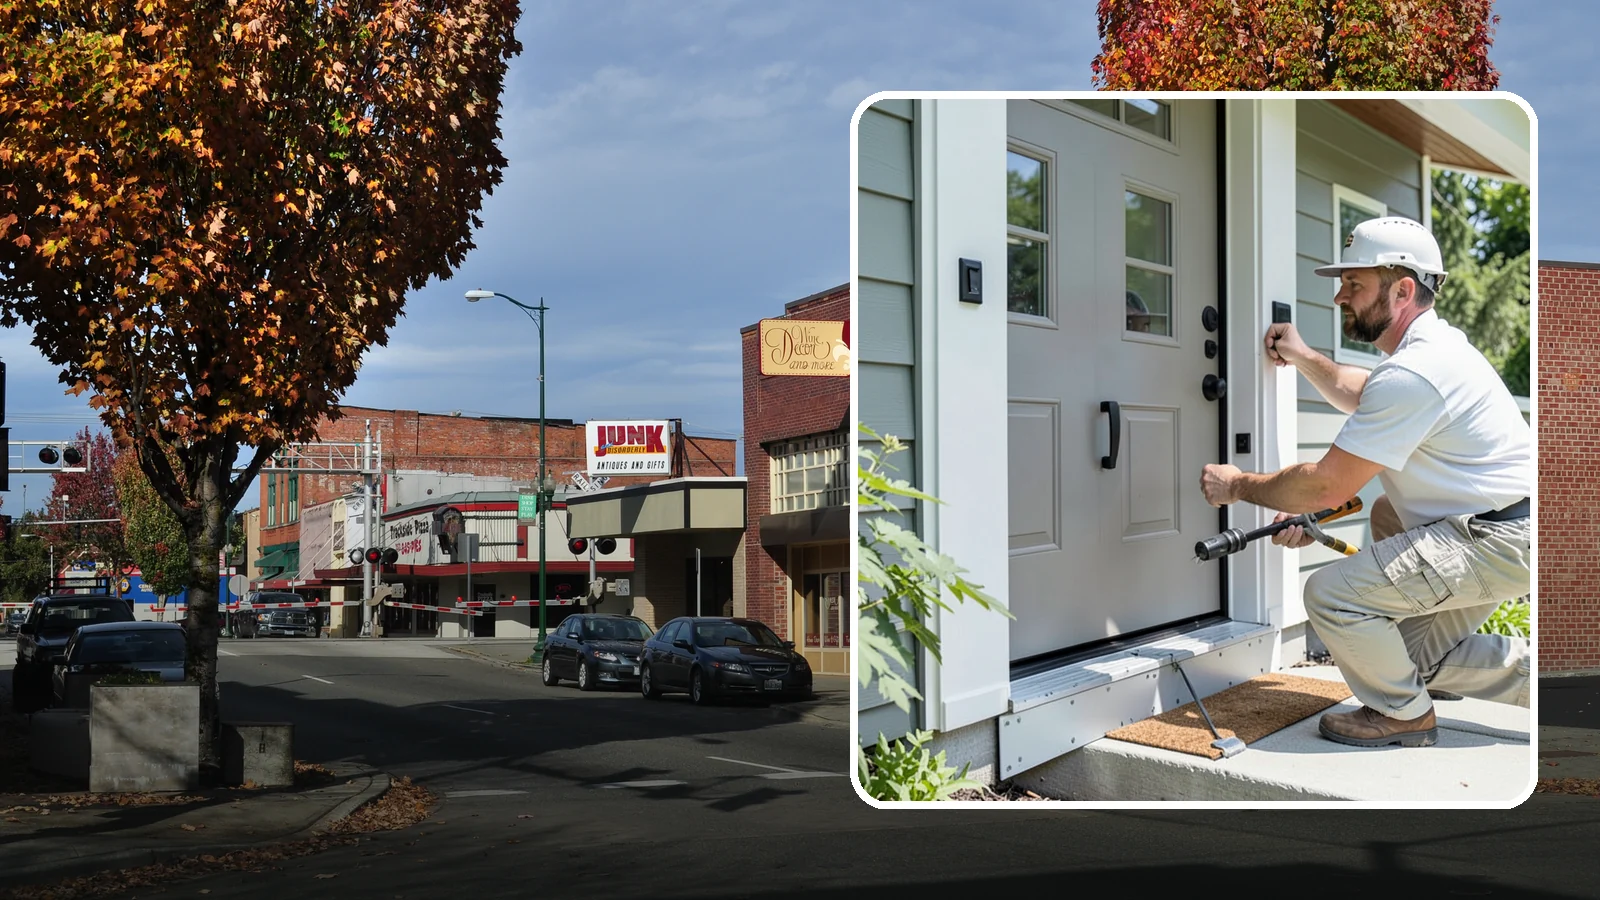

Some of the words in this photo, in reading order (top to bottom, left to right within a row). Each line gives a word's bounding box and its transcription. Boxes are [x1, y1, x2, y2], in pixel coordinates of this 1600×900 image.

[595, 425, 665, 457] JUNK
[607, 446, 646, 454] DISORDERLY
[596, 461, 628, 470] ANTIQUES
[631, 461, 644, 470] AND
[647, 460, 666, 469] GIFTS
[390, 520, 412, 539] Trackside
[414, 519, 429, 534] Pizza
